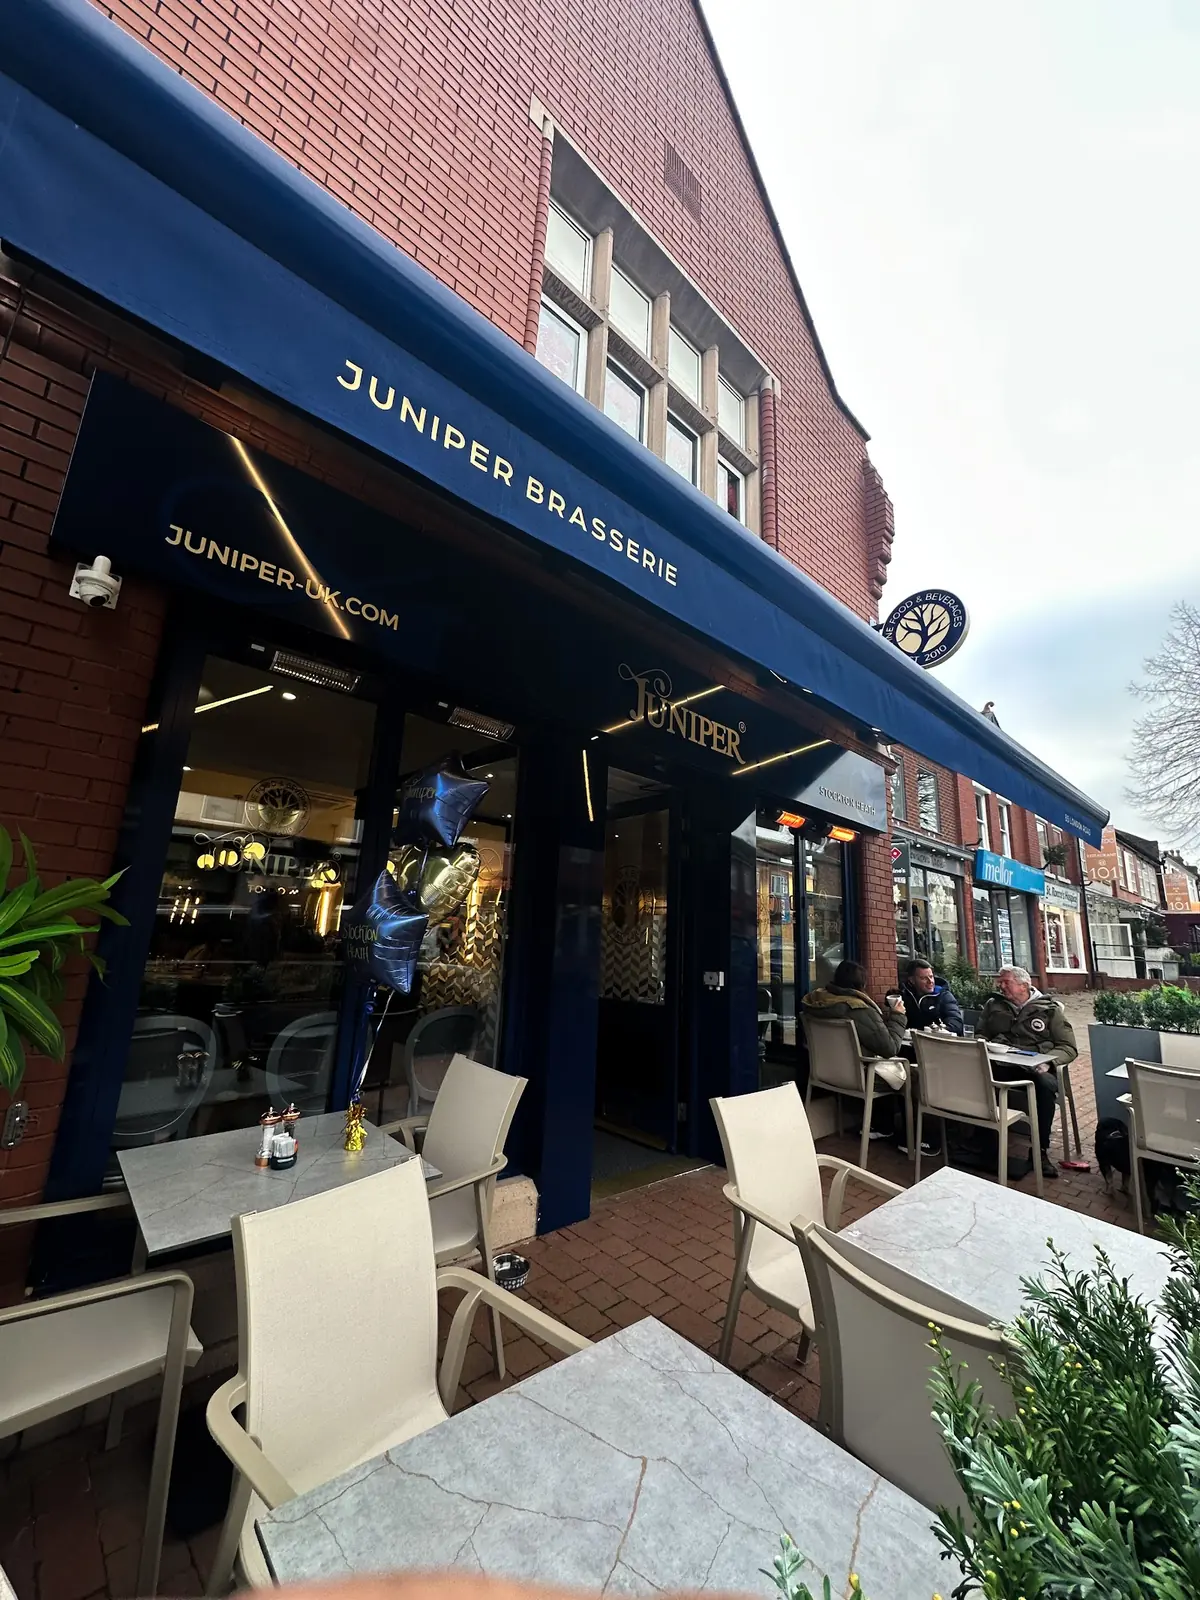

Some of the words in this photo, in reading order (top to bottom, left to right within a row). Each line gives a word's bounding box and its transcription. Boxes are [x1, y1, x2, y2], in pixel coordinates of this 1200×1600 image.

[336, 359, 514, 487] JUNIPER
[525, 475, 678, 587] BRASSERIE
[164, 524, 400, 632] JUNIPER-UK.COM
[889, 600, 913, 624] FOOD
[915, 595, 923, 603] &
[925, 592, 963, 628] BEVERAGES
[924, 644, 947, 662] 2010
[618, 662, 746, 765] JUNIPER
[819, 786, 855, 808] STOCKTON
[855, 800, 877, 816] HEATH
[984, 857, 1014, 886] mellor
[1088, 865, 1119, 879] 101
[1169, 901, 1191, 911] 101
